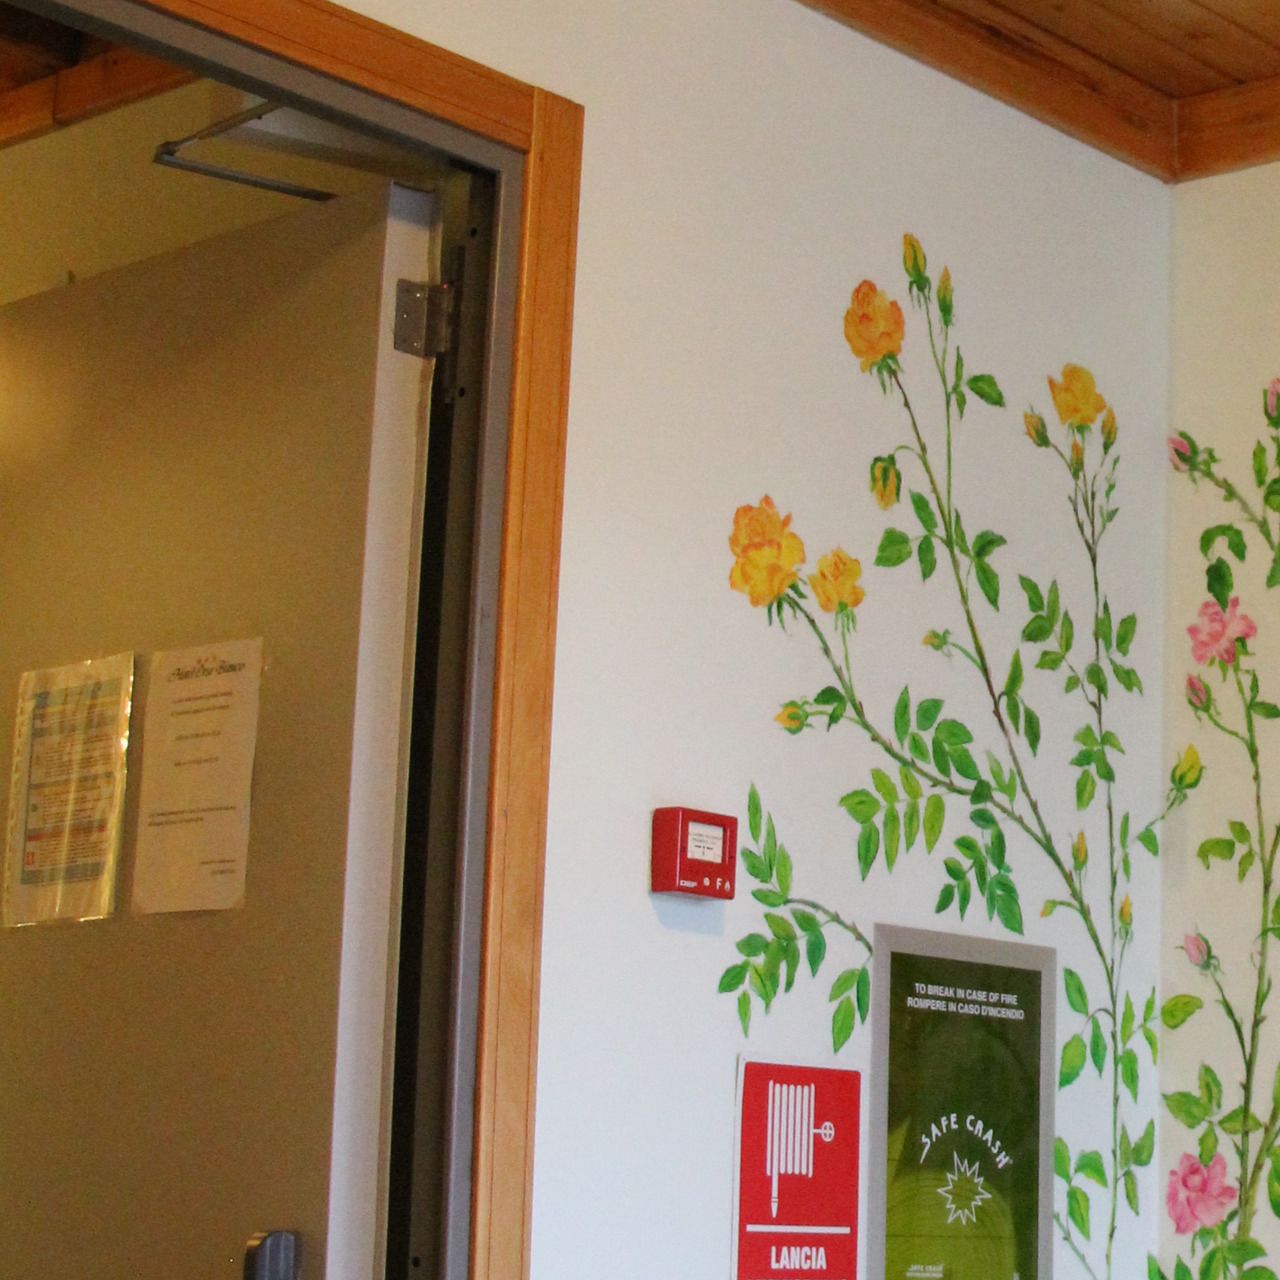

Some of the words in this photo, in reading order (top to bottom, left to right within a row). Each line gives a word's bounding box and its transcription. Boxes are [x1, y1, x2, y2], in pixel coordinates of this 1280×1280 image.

[915, 983, 926, 994] TO
[927, 984, 955, 998] BREAK
[956, 988, 965, 999] IN
[966, 989, 988, 1001] CASE
[988, 991, 1000, 1002] OF
[1000, 993, 1018, 1005] FIRE
[907, 997, 947, 1011] ROMPERE
[948, 1001, 957, 1012] IN
[958, 1002, 980, 1015] CASO
[981, 1005, 1025, 1020] D'INCENDIO
[920, 1113, 959, 1164] SAFE
[966, 1114, 1010, 1169] CRASH
[770, 1246, 827, 1270] LANCIA
